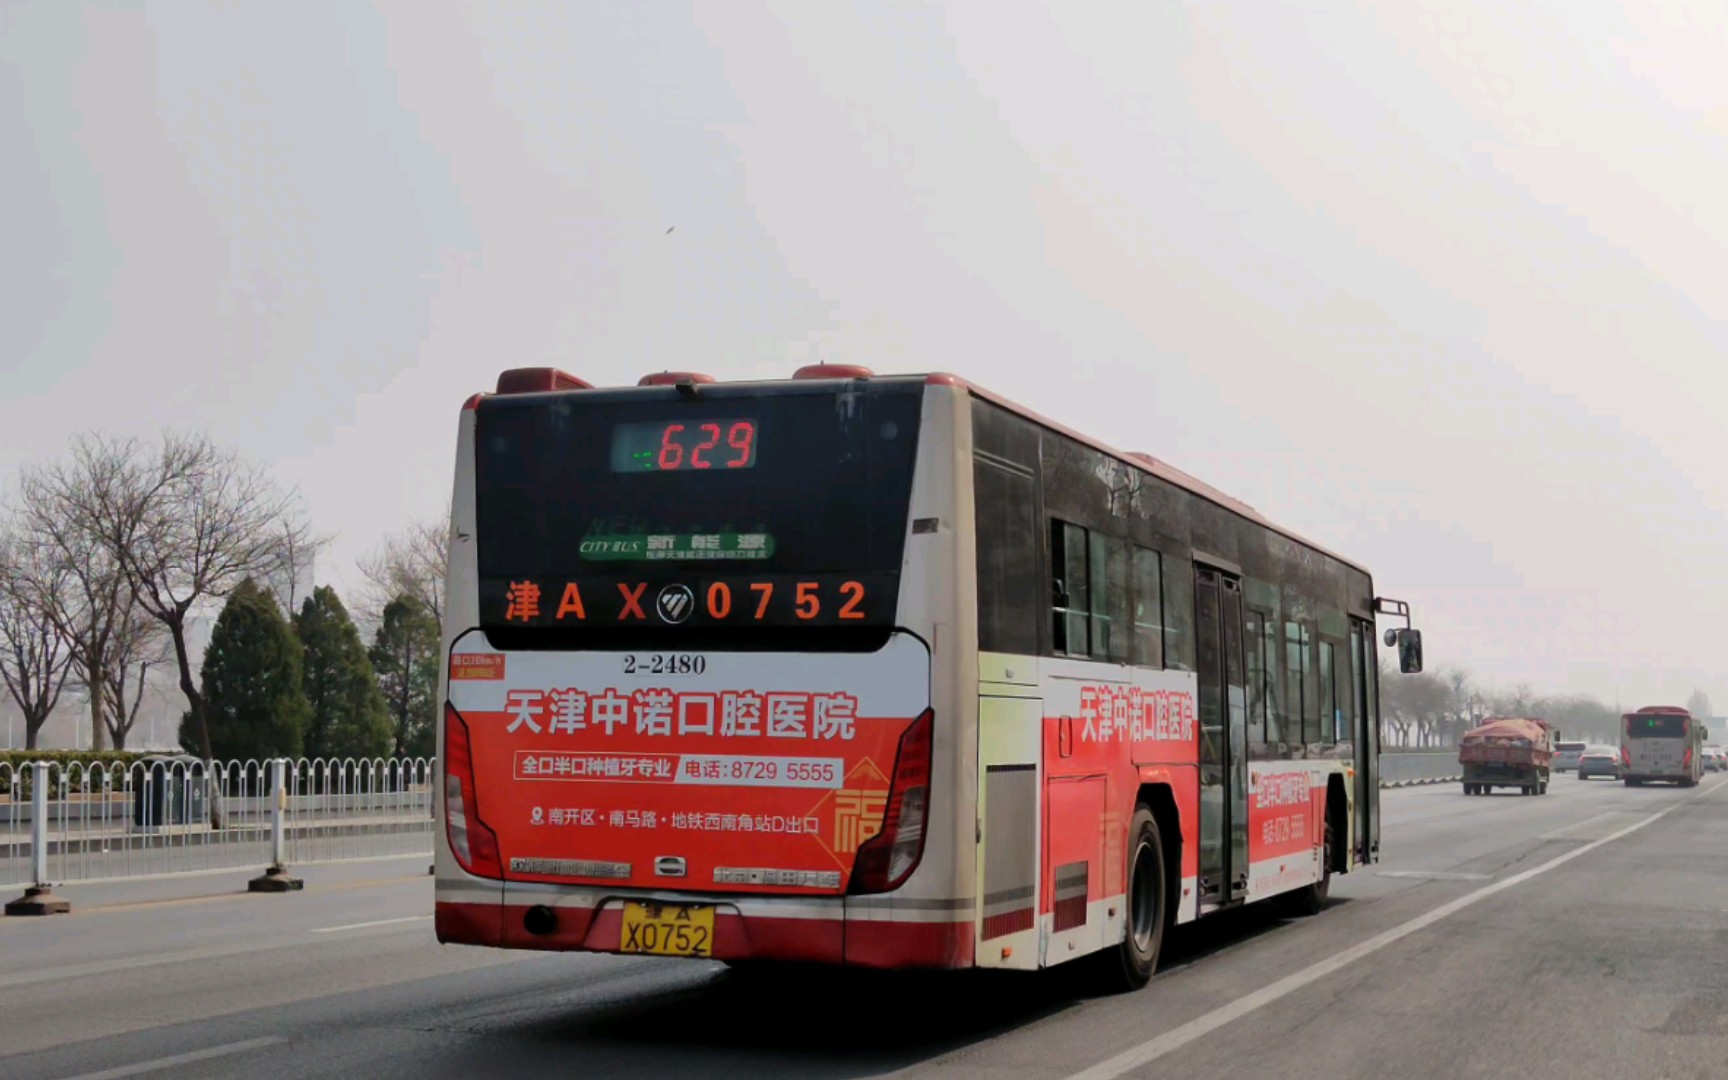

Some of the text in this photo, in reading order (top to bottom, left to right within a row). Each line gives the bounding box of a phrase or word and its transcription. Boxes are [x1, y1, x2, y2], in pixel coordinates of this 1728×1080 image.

[658, 422, 754, 470] 629
[579, 541, 642, 553] CITY BUS
[624, 654, 706, 675] 2-2480
[506, 690, 858, 741] 天津中诺口腔医院
[1080, 686, 1194, 742] 天津中诺口腔医院
[522, 755, 672, 779] 全口半口种植牙专业
[786, 762, 835, 782] 5555
[625, 922, 707, 953] X0752
